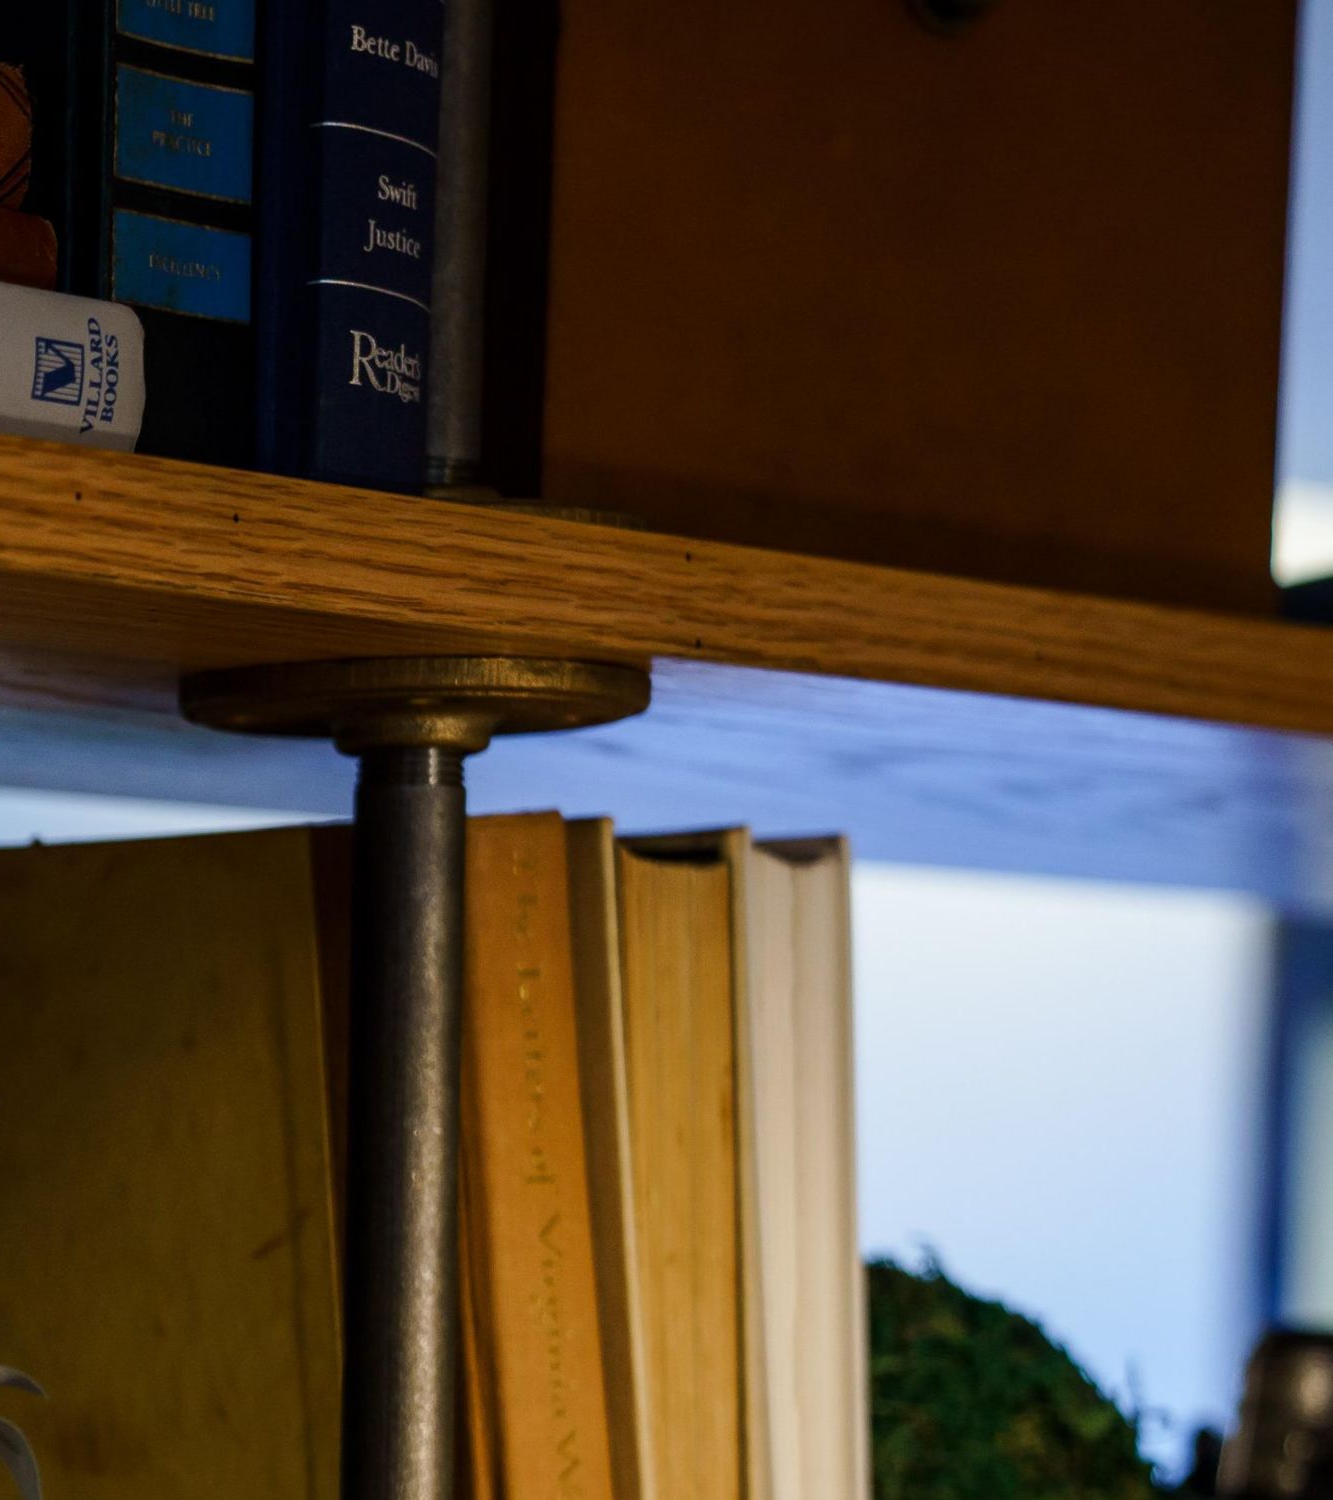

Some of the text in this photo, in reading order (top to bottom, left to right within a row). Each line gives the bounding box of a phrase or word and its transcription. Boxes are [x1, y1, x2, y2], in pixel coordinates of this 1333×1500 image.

[350, 25, 401, 62] Bette
[377, 174, 418, 211] Swift
[364, 219, 421, 259] Justice
[79, 317, 103, 434] VILLARD
[100, 333, 119, 423] BOOKS
